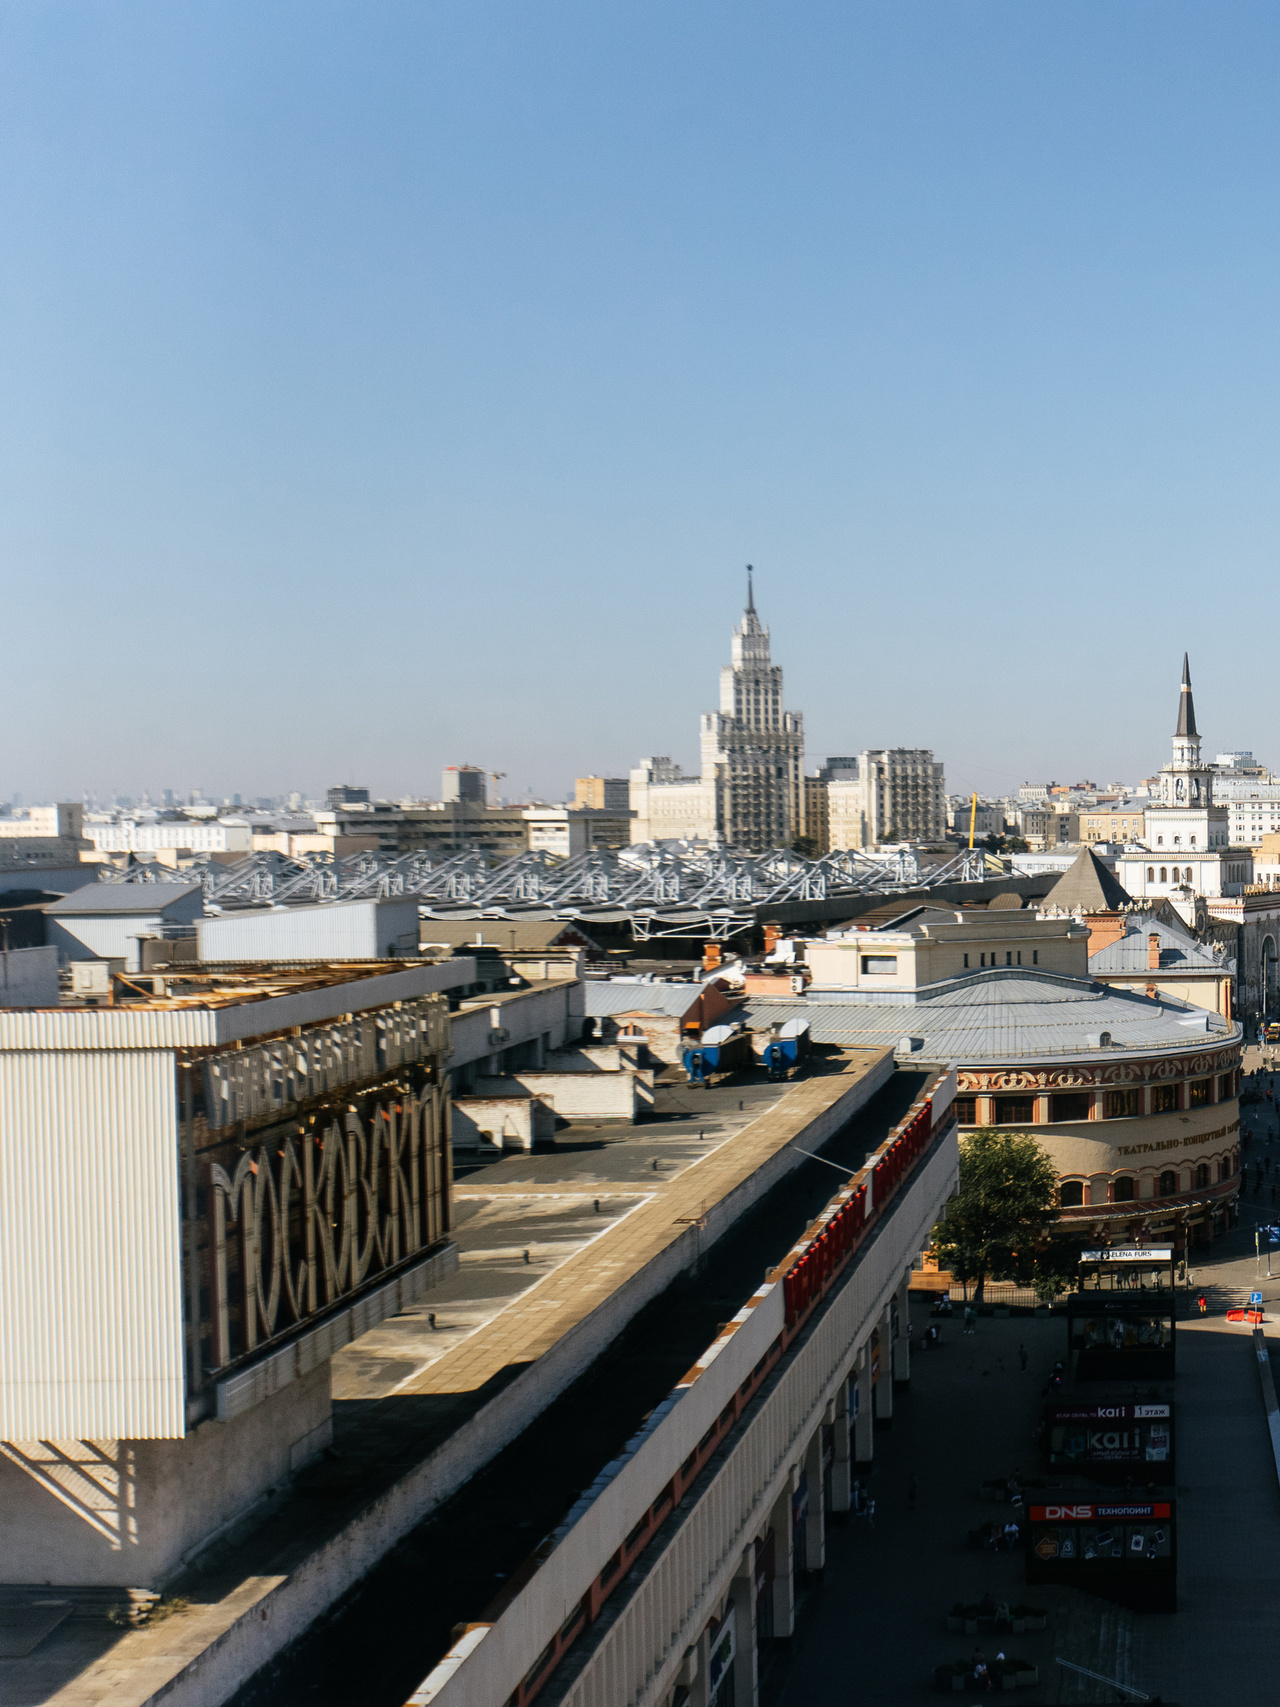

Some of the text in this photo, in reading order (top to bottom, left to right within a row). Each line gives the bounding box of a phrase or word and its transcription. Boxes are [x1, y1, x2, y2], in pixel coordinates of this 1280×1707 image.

[1117, 1125, 1227, 1156] ТЕАТРАЛЬНО-КОНЦЕРТНЫЙ
[1097, 1406, 1126, 1418] kari
[1087, 1427, 1140, 1449] kari
[1045, 1505, 1092, 1519] DNS
[1097, 1506, 1152, 1516] ТЕХНОПОИНТ
